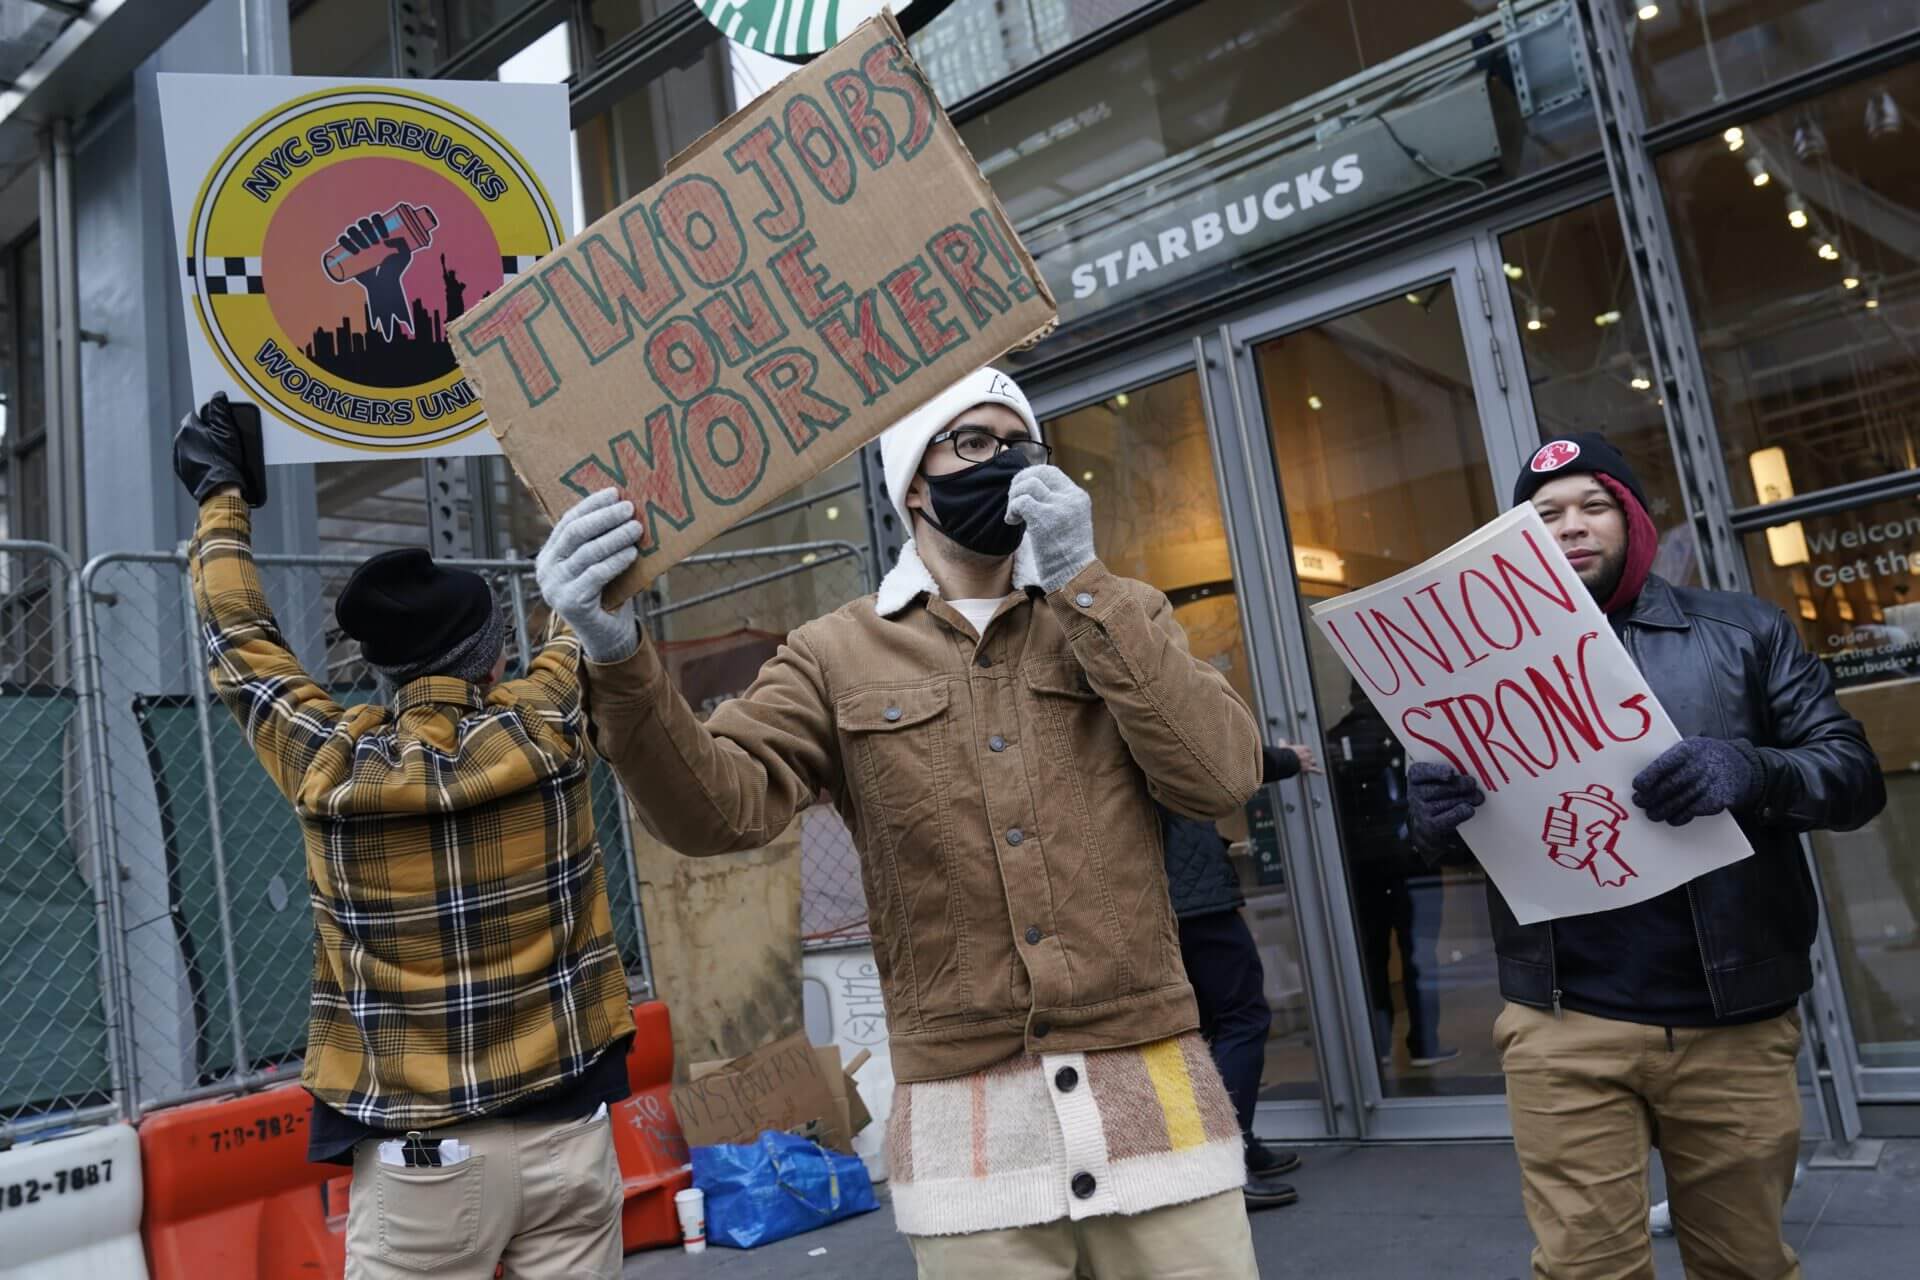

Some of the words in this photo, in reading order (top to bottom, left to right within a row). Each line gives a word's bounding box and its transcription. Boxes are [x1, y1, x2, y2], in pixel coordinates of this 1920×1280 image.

[242, 137, 311, 202] NYC
[306, 118, 508, 201] STARBUCKS
[459, 173, 748, 408] TWO
[725, 37, 938, 242] JOBS
[1072, 153, 1364, 299] STARBUCKS
[255, 338, 415, 425] WORKERS
[561, 208, 1034, 558] WORKER!
[644, 235, 856, 402] ONE
[1327, 530, 1577, 696] UNION
[1814, 559, 1871, 588] Get
[1827, 631, 1869, 647] Order
[1401, 631, 1652, 792] STRONG
